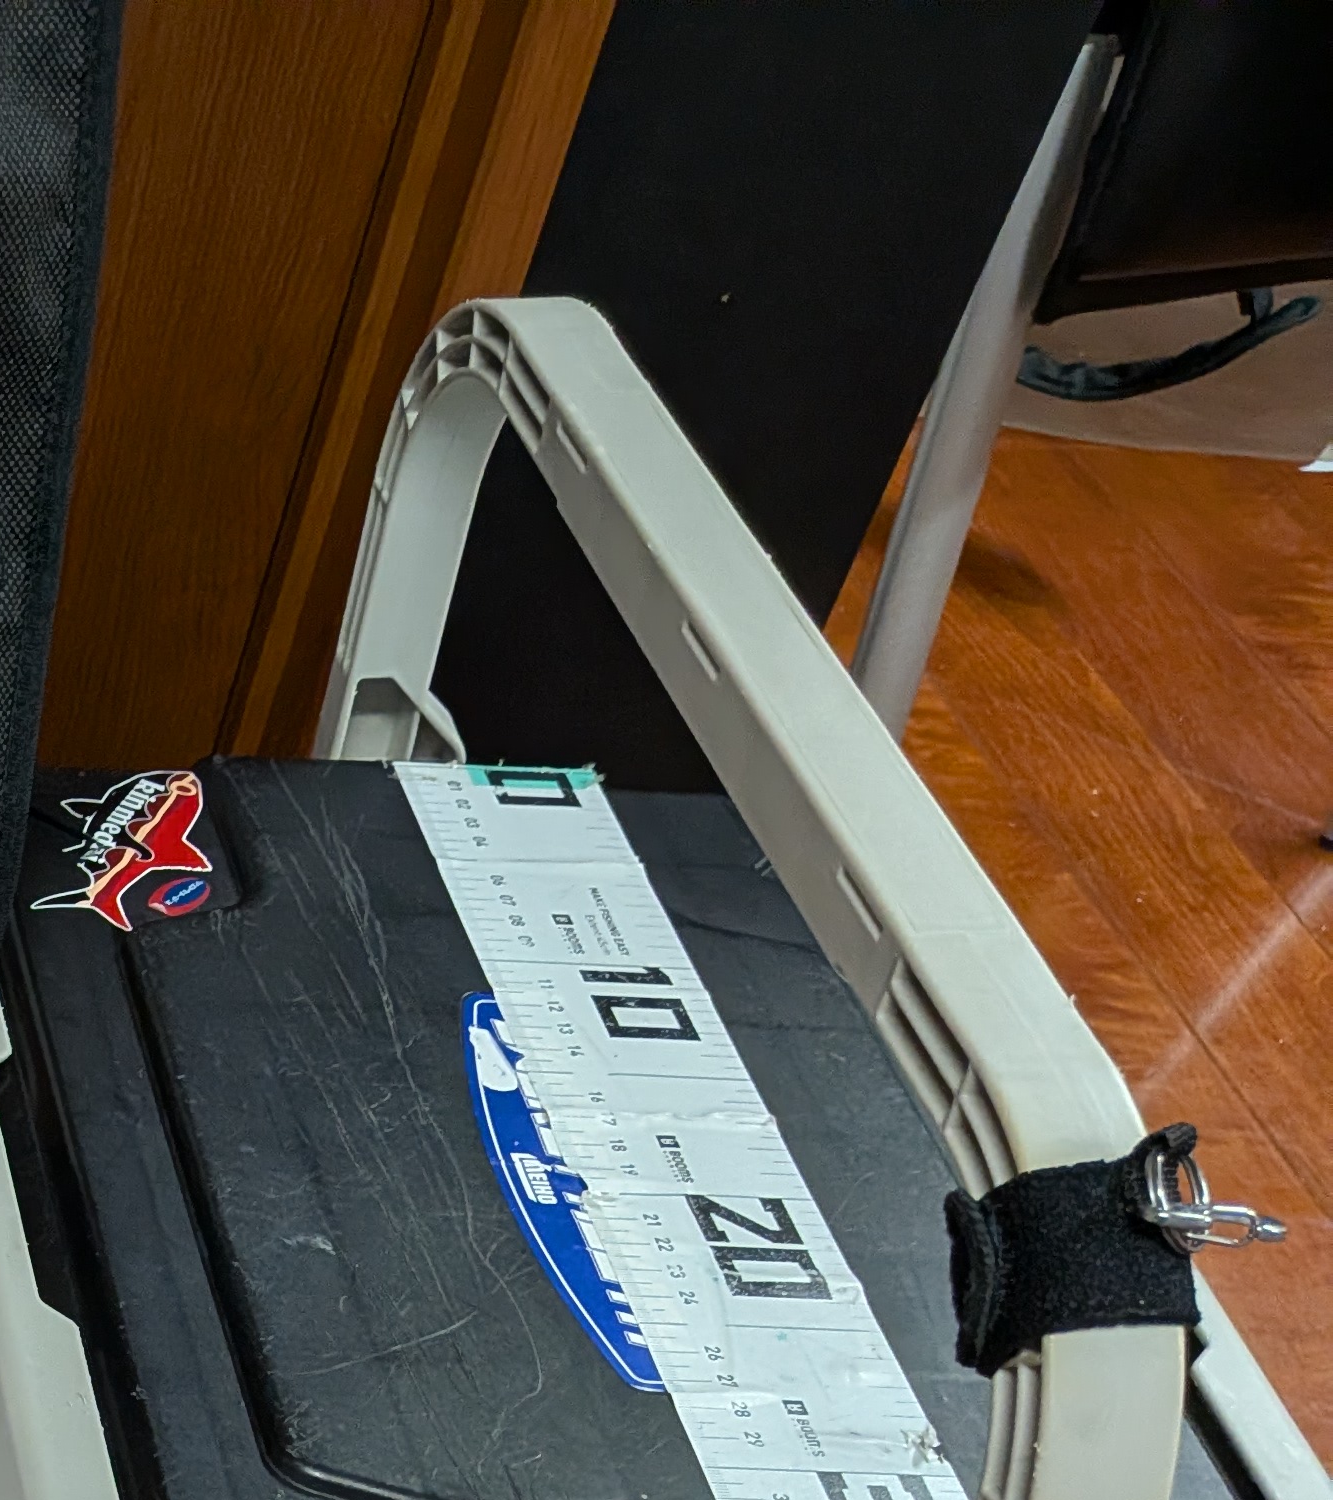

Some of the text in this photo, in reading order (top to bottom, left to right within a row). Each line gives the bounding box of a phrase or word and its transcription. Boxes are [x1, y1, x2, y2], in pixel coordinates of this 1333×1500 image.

[547, 1001, 564, 1013] 12
[579, 965, 702, 1042] 10
[557, 1023, 574, 1035] 13
[609, 1139, 628, 1152] 18
[643, 1213, 662, 1227] 21
[654, 1237, 675, 1253] 22
[684, 1194, 833, 1301] 20
[703, 1345, 725, 1362] 26
[716, 1374, 739, 1388] 27
[730, 1400, 751, 1418] 28
[743, 1431, 764, 1448] 29
